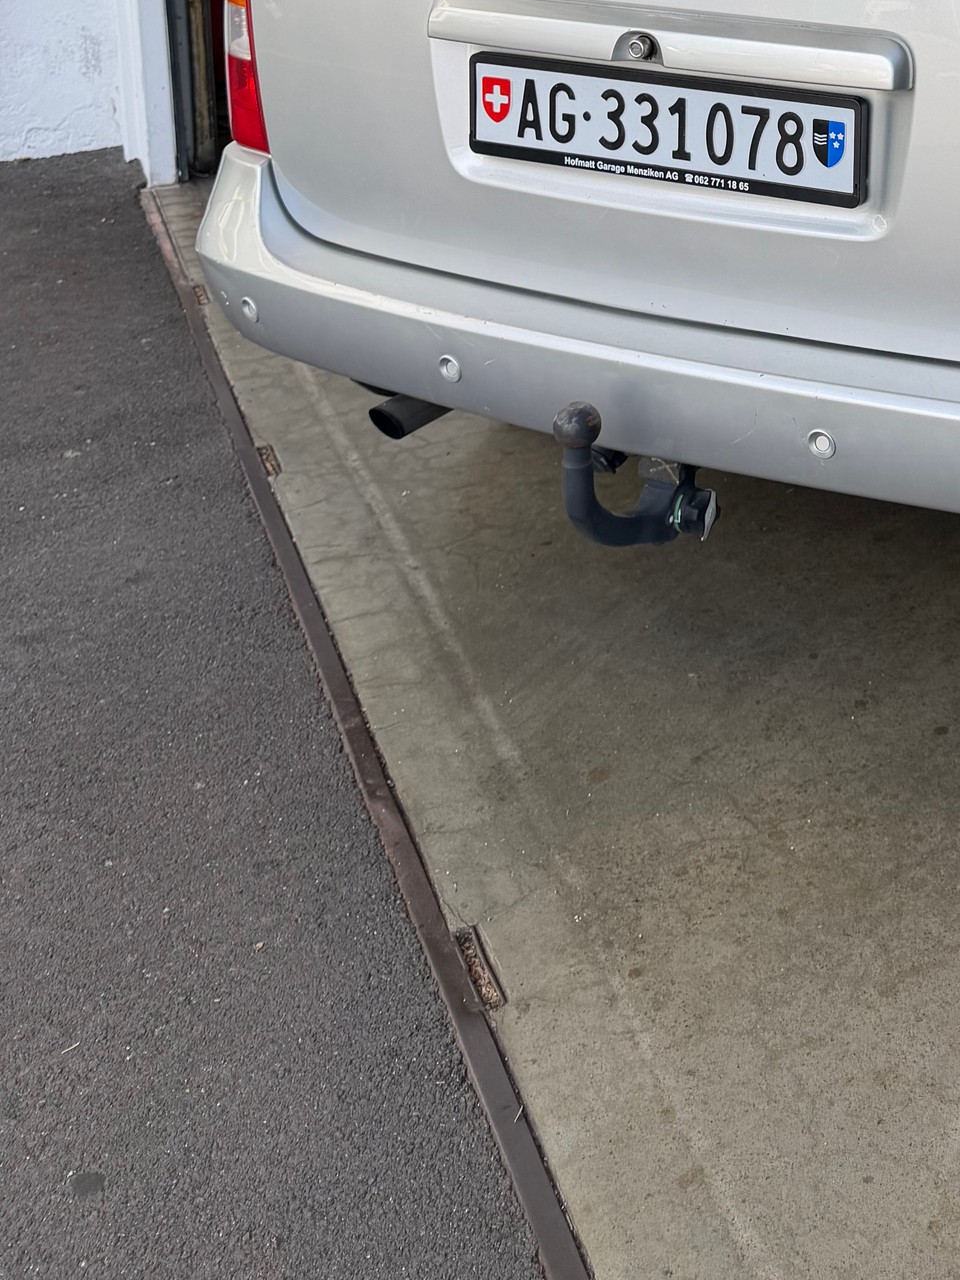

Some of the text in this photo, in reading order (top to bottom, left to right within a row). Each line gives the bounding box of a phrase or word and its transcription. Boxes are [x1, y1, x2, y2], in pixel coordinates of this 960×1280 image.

[564, 156, 750, 191] Hofmatt Garage Menziken AG 062 771 18 65
